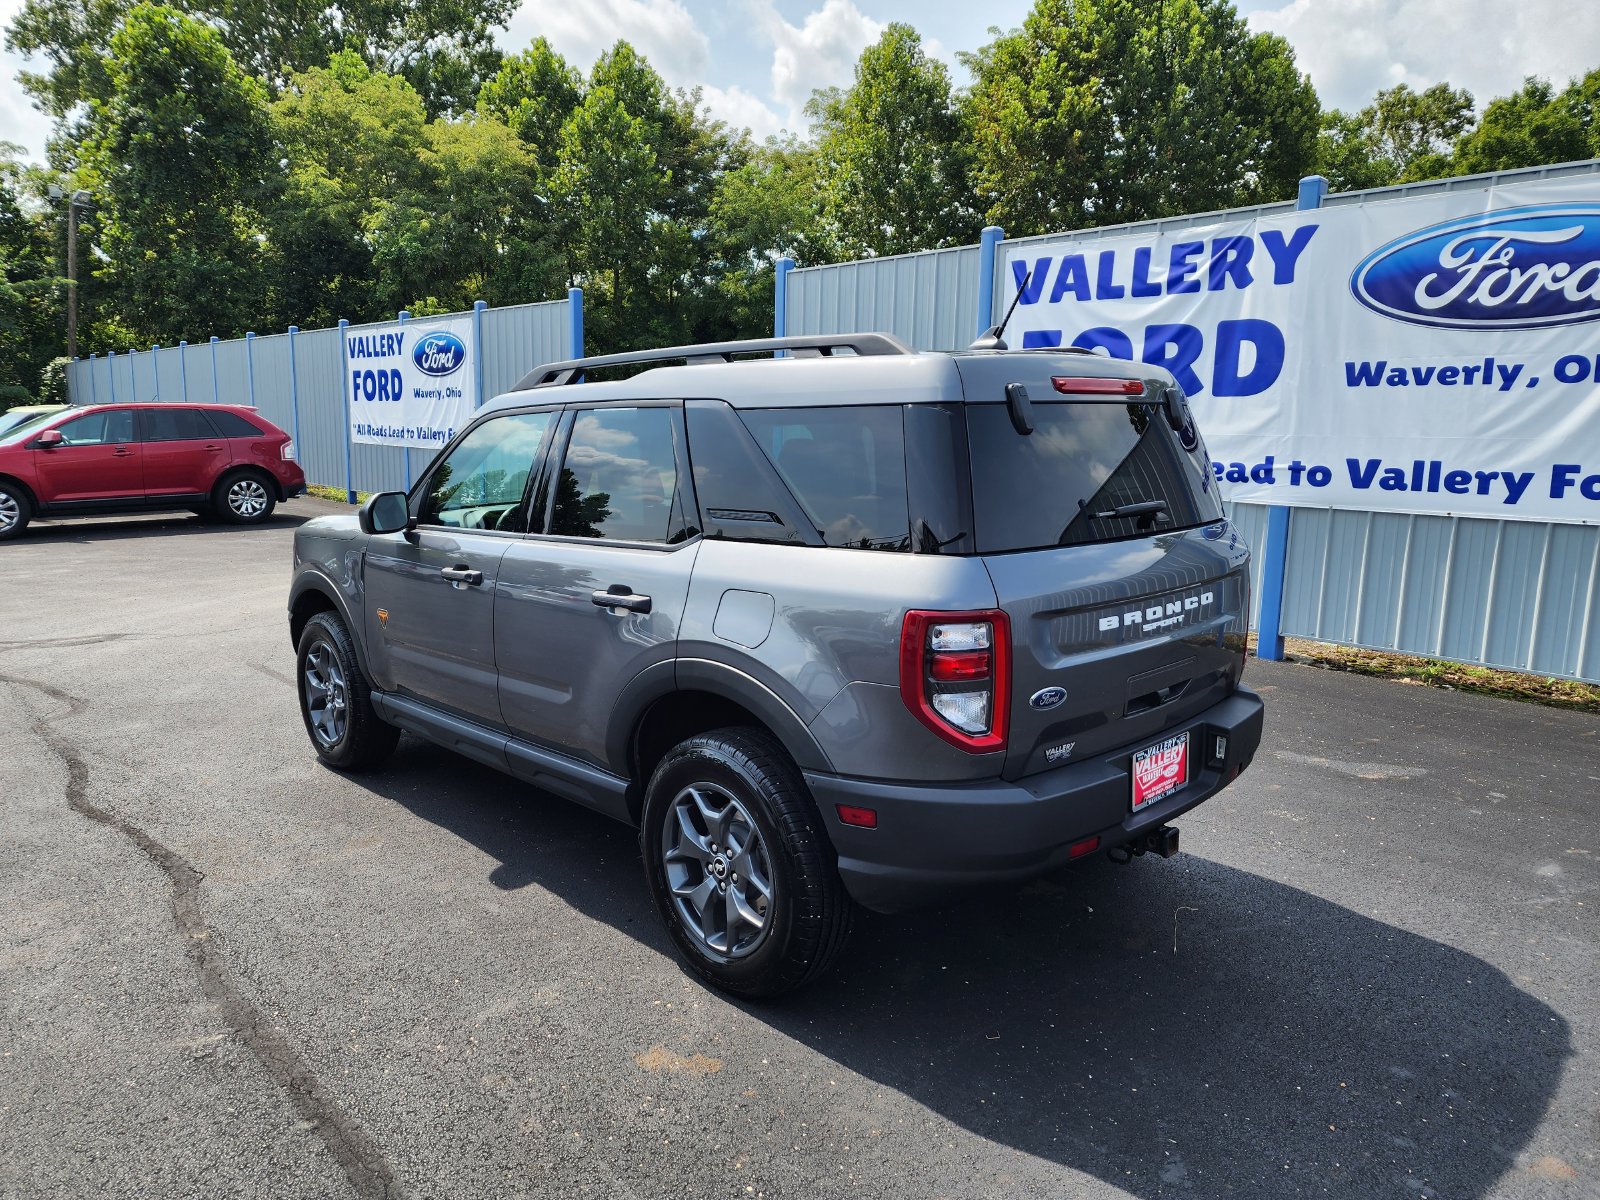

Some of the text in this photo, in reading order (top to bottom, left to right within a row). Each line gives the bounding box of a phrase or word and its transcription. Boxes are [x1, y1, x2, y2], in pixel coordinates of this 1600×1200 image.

[1011, 224, 1319, 305] VALLERY
[348, 332, 404, 359] VALLERY
[422, 339, 455, 368] Ford
[1022, 319, 1285, 397] RD
[353, 369, 403, 402] FORD
[1345, 354, 1600, 391] Waverly, O
[446, 387, 462, 398] Ohio
[367, 424, 387, 437] Roads
[388, 425, 405, 439] Lead
[407, 427, 414, 439] to
[417, 427, 446, 443] Vallery
[1288, 460, 1332, 487] to
[1346, 458, 1535, 504] Vallery
[1099, 591, 1213, 631] BRONCO
[1142, 615, 1185, 632] SPORT
[1040, 692, 1060, 705] Ford
[1045, 741, 1076, 757] VALLERY
[1136, 742, 1186, 775] VALLERY
[1147, 737, 1176, 757] VALLERY
